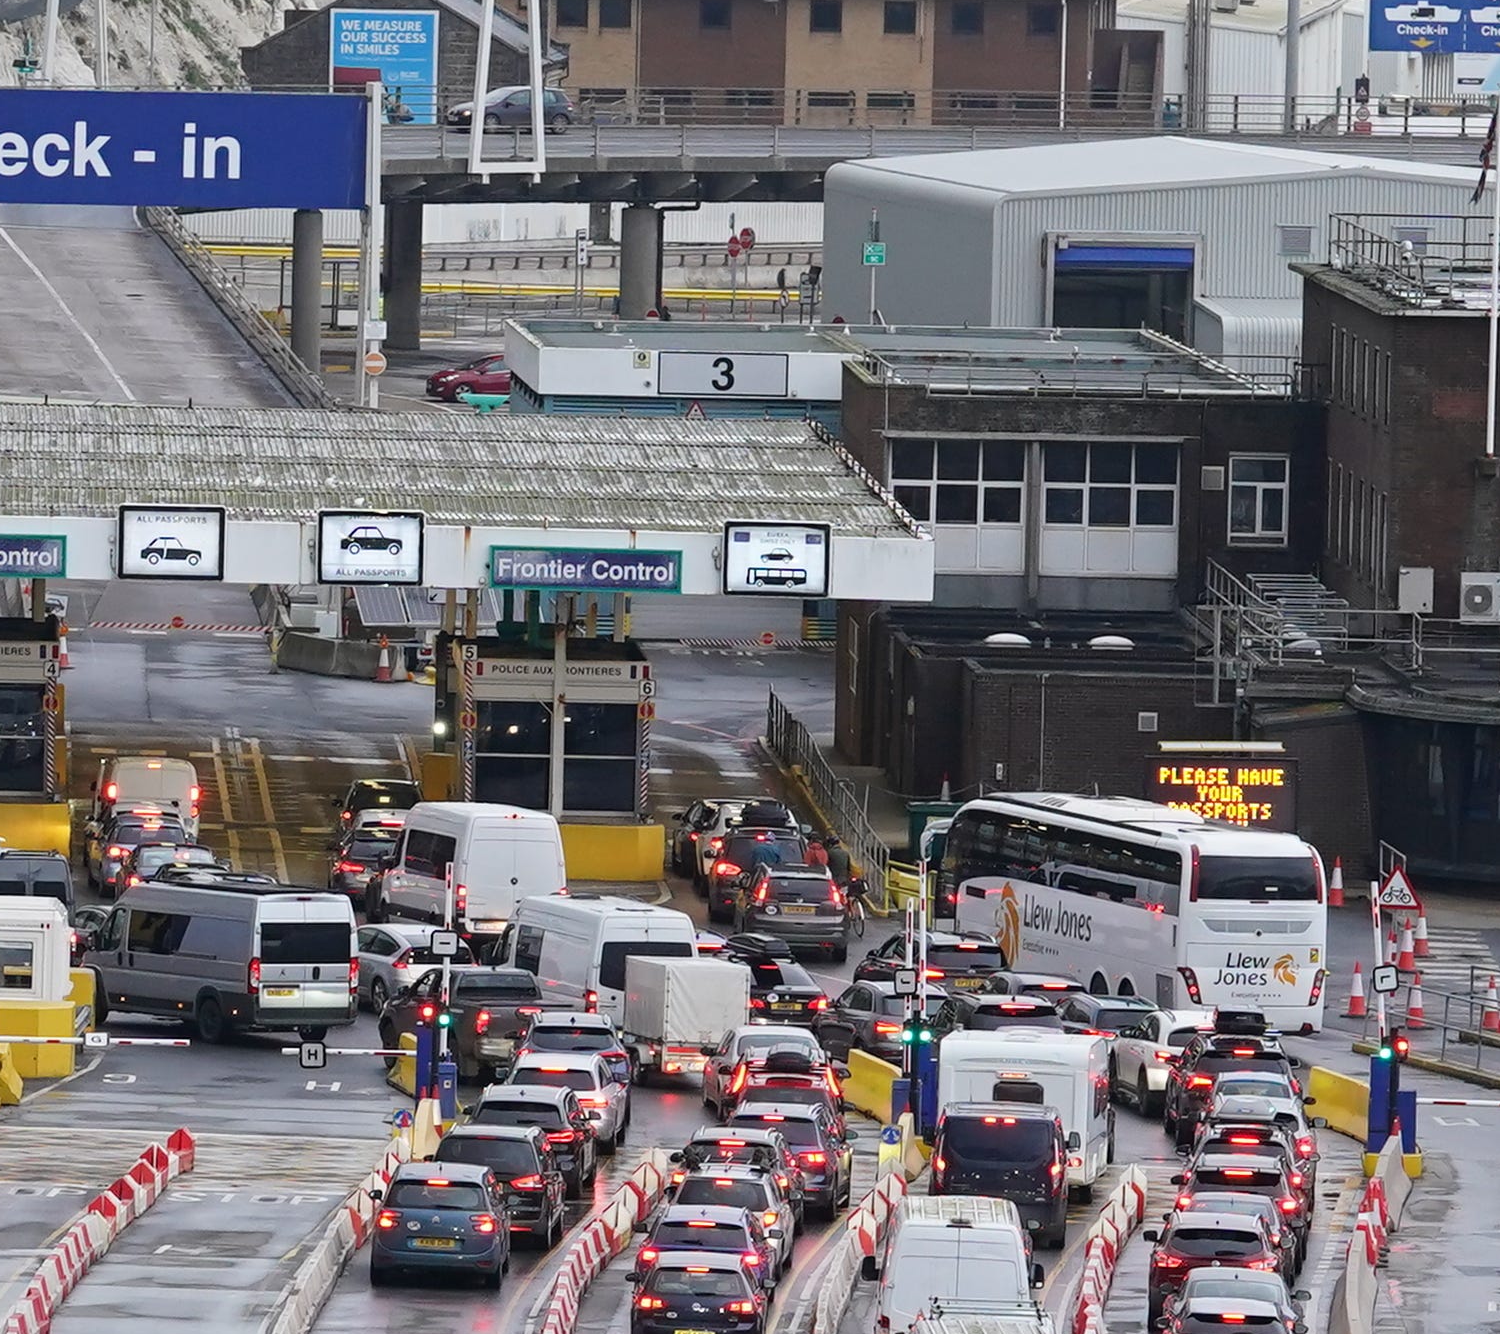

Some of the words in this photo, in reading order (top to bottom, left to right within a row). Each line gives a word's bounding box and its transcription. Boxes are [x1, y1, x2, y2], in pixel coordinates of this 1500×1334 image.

[341, 19, 361, 32] WE
[363, 19, 423, 33] MEASURE
[340, 31, 363, 43] OUR
[365, 31, 427, 44] SUCCESS
[341, 42, 354, 55] IN
[356, 43, 400, 56] SMILES
[182, 123, 242, 179] in
[710, 357, 736, 391] 3
[137, 516, 153, 524] ALL
[154, 516, 207, 525] PASSPORTS
[335, 569, 352, 577] ALL
[353, 569, 407, 578] PASSPORTS
[497, 558, 585, 579] Frontier
[591, 560, 674, 581] Control
[464, 647, 474, 660] 5
[47, 664, 57, 676] 4
[491, 664, 528, 676] POLICE
[532, 665, 553, 677] AUX
[564, 667, 622, 678] RONTIERES
[643, 681, 653, 695] 6
[1159, 767, 1229, 785] PLEASE
[1237, 767, 1284, 786] HAVE
[1196, 785, 1243, 802] YOUR
[1023, 894, 1053, 931] Llew
[1053, 897, 1091, 942] Jones
[1225, 952, 1270, 969] Llew
[1212, 969, 1268, 987] Jones
[307, 1049, 318, 1061] H
[167, 1192, 329, 1205] STOP
